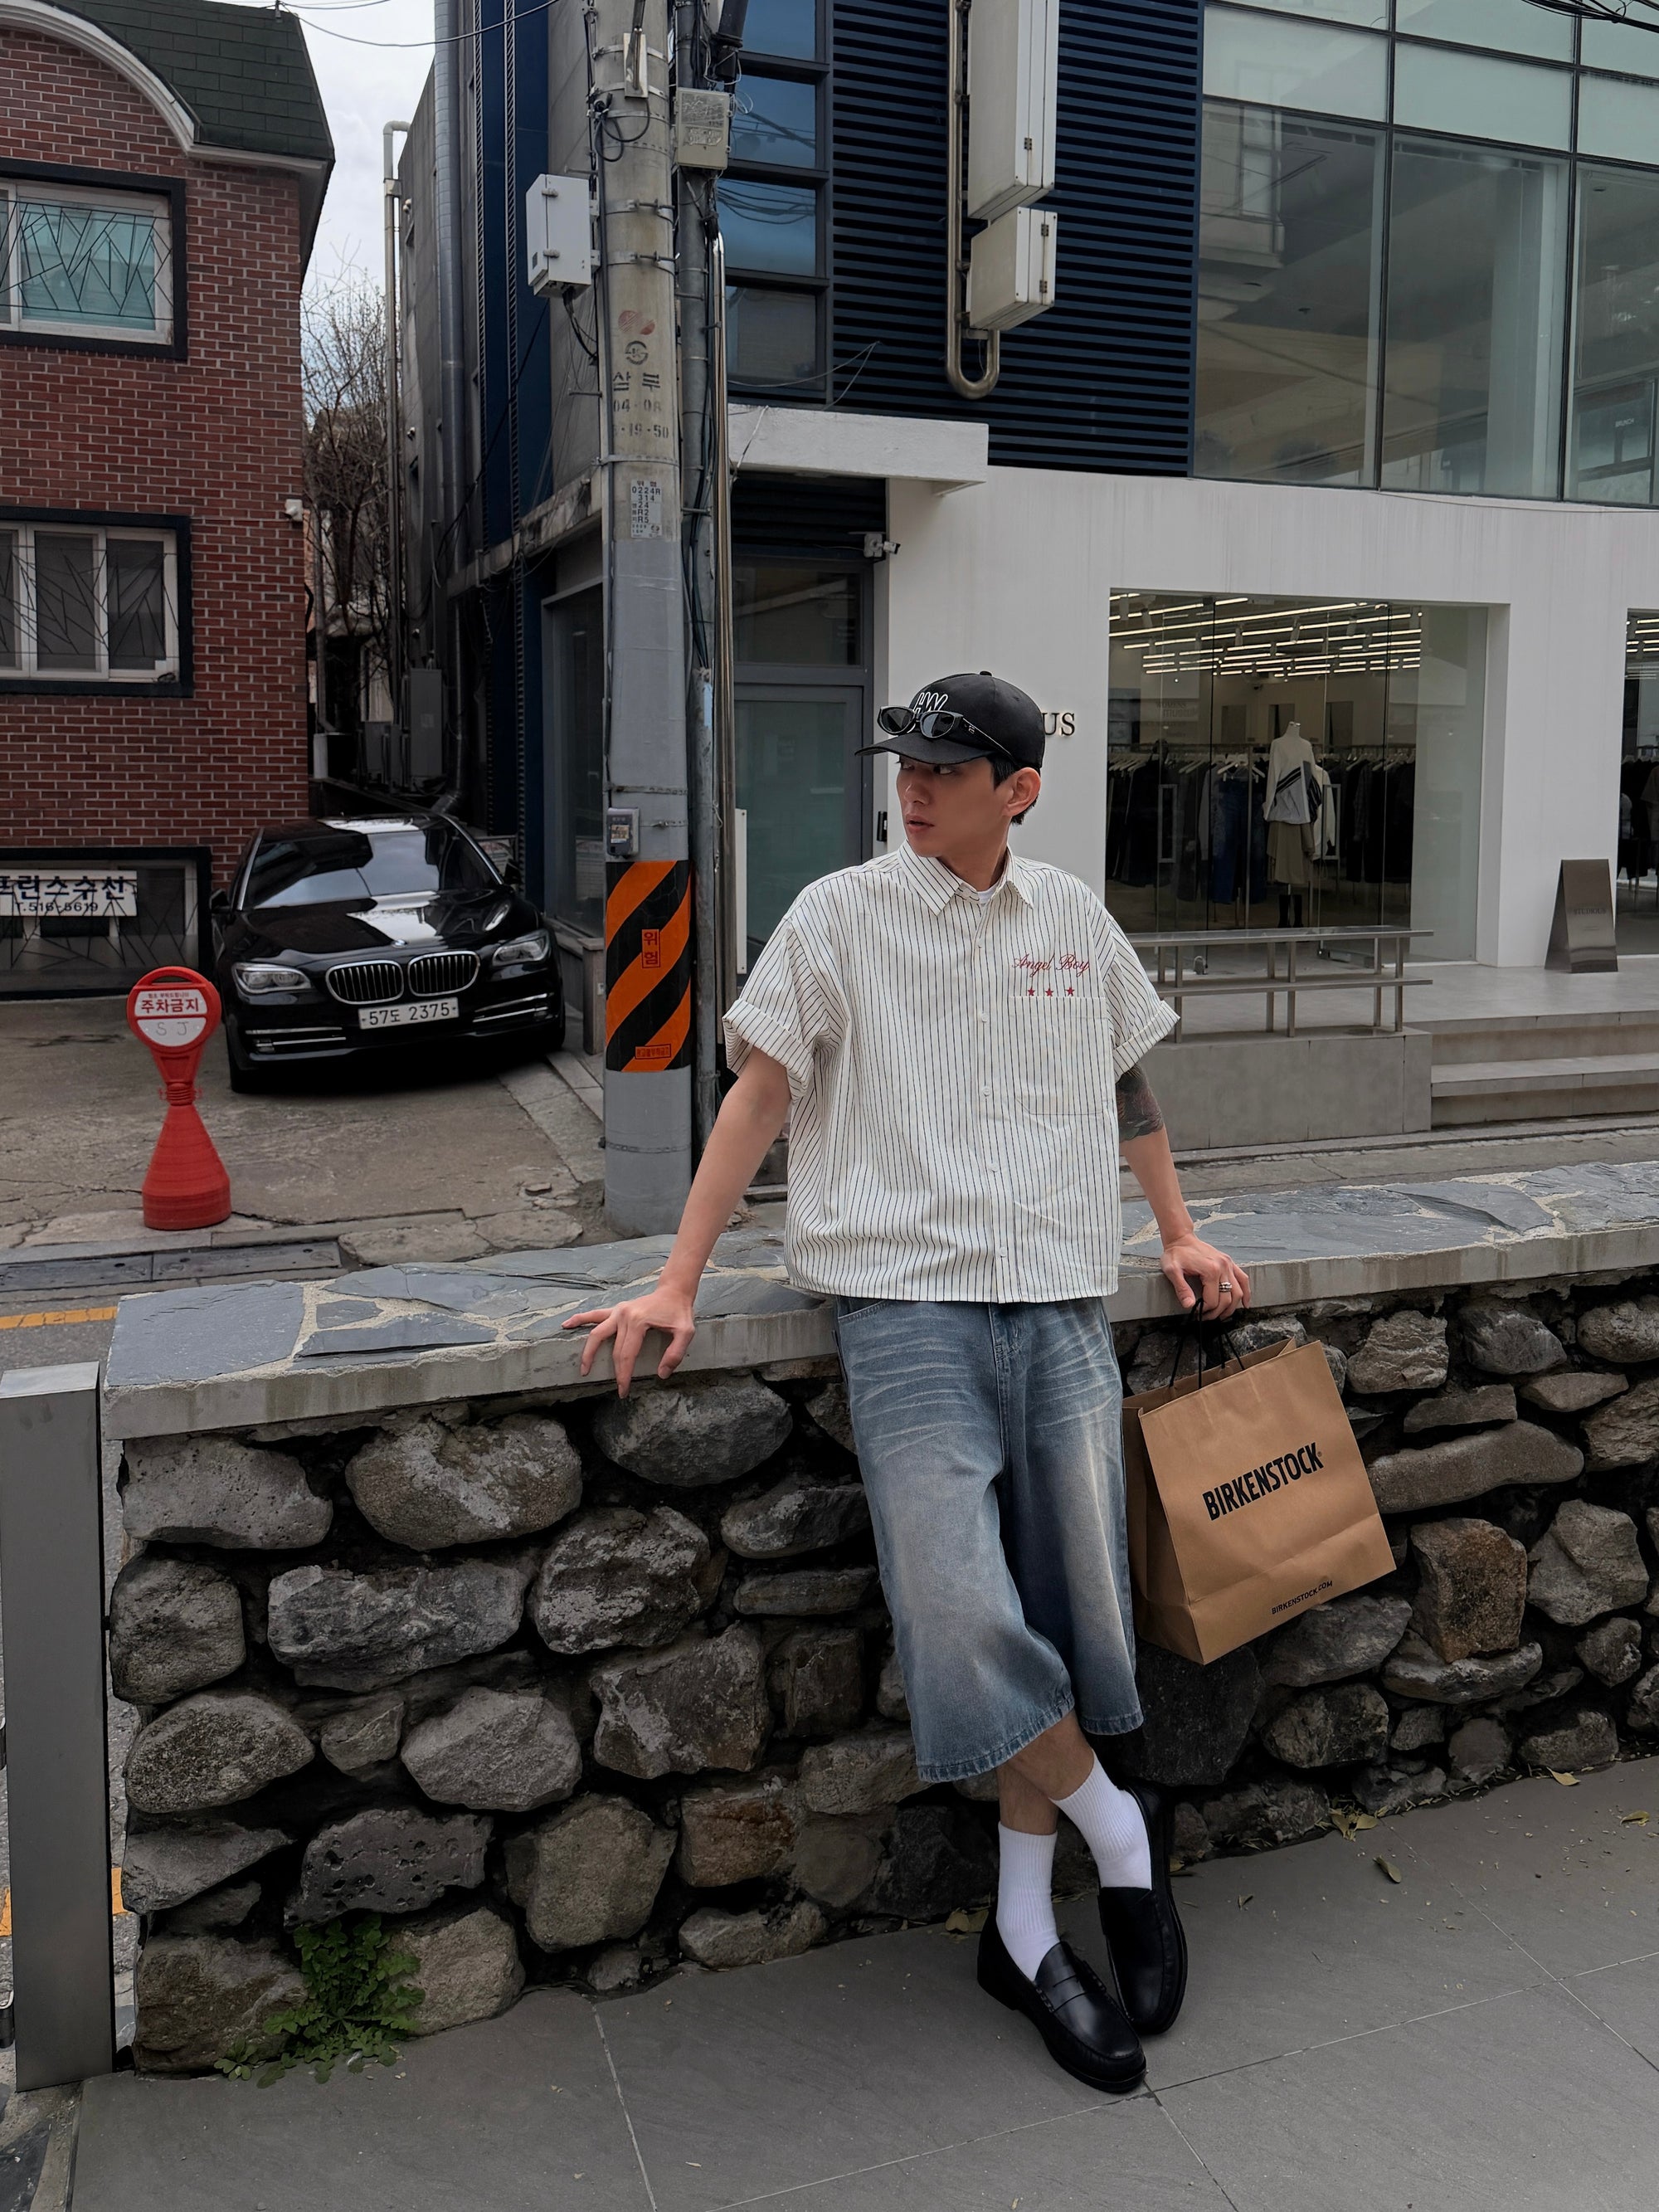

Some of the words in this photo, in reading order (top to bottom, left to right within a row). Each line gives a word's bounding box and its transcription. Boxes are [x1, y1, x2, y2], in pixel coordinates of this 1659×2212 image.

[643, 931, 659, 965] 위험
[1012, 953, 1056, 978] Angel
[1055, 953, 1091, 978] Boy
[141, 997, 199, 1014] 주차금지
[409, 1002, 450, 1021] 2375
[1202, 1442, 1324, 1521] BIRKENSTOCK
[1272, 1580, 1333, 1615] BIRKENSTOCK.COM
